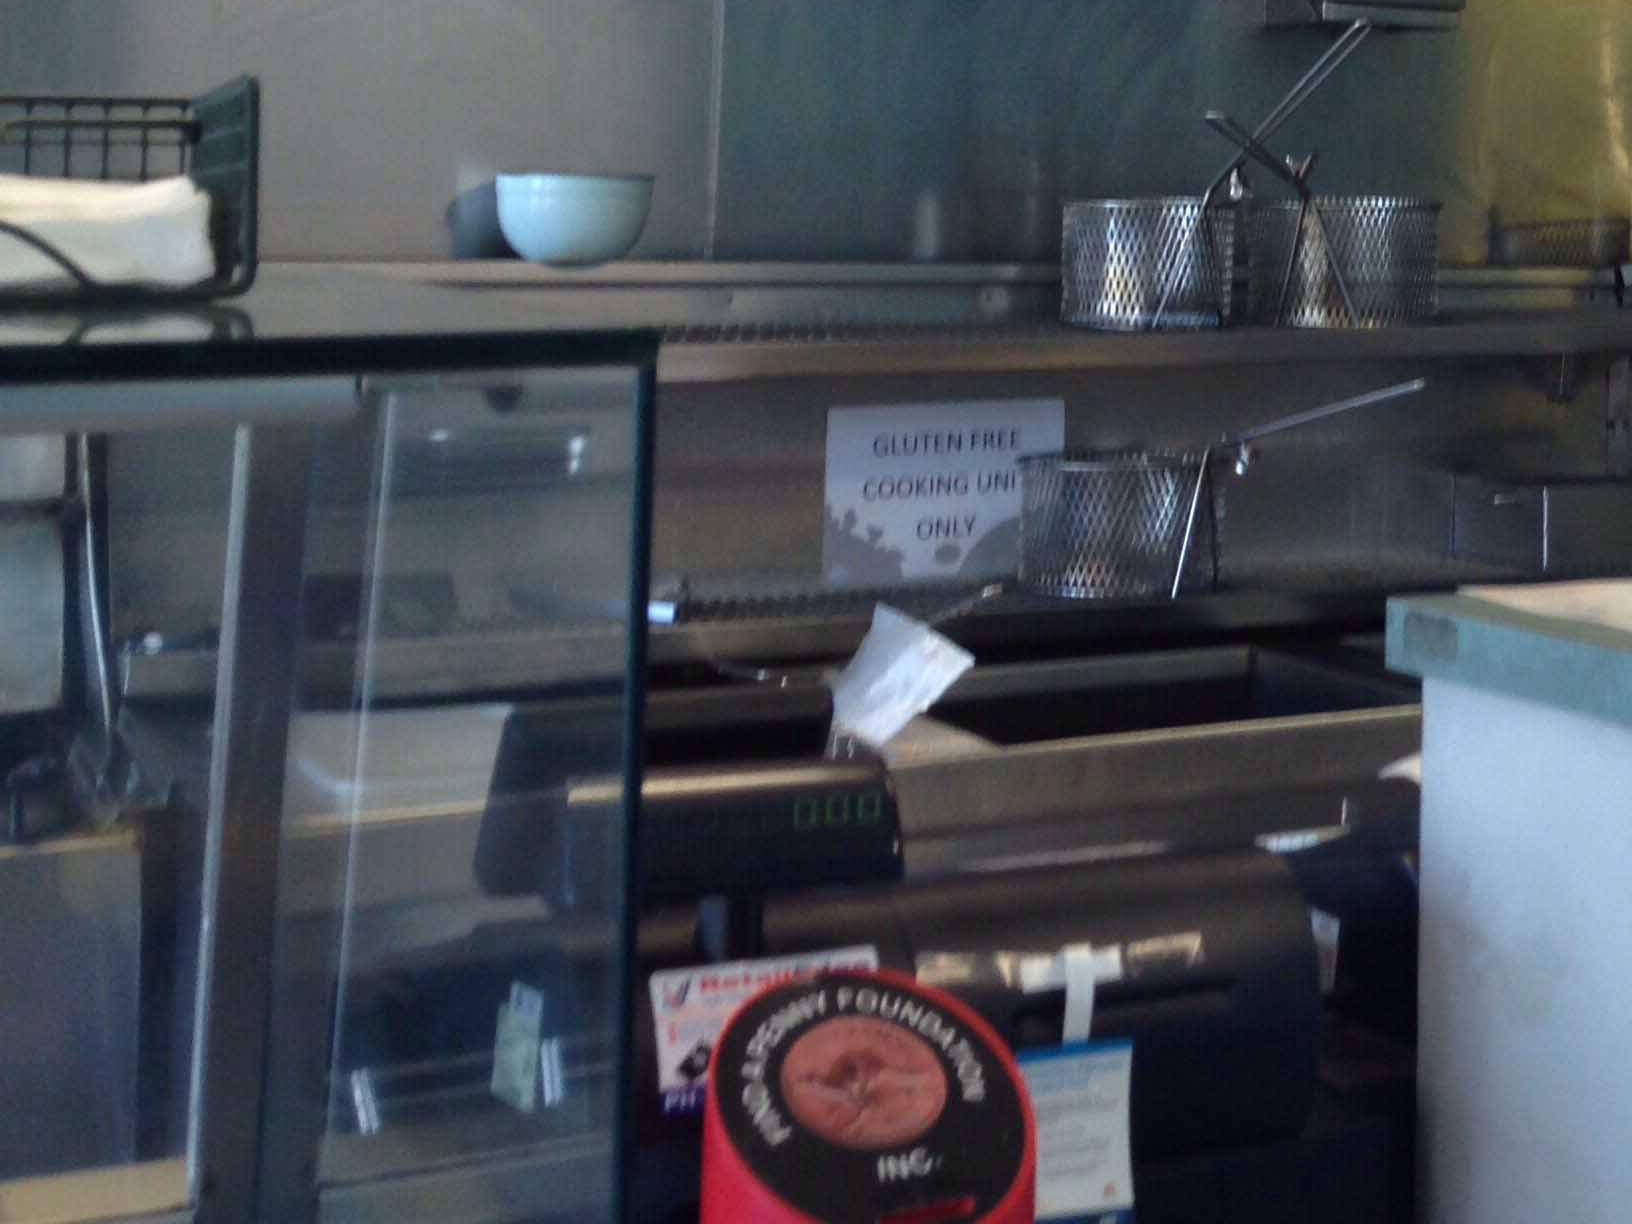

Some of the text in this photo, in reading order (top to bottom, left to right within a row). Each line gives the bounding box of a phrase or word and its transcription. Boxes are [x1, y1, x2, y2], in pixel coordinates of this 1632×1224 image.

[873, 427, 1021, 458] GLUTEN FREE
[863, 470, 1016, 501] COOKING UNI
[916, 515, 976, 541] ONLY
